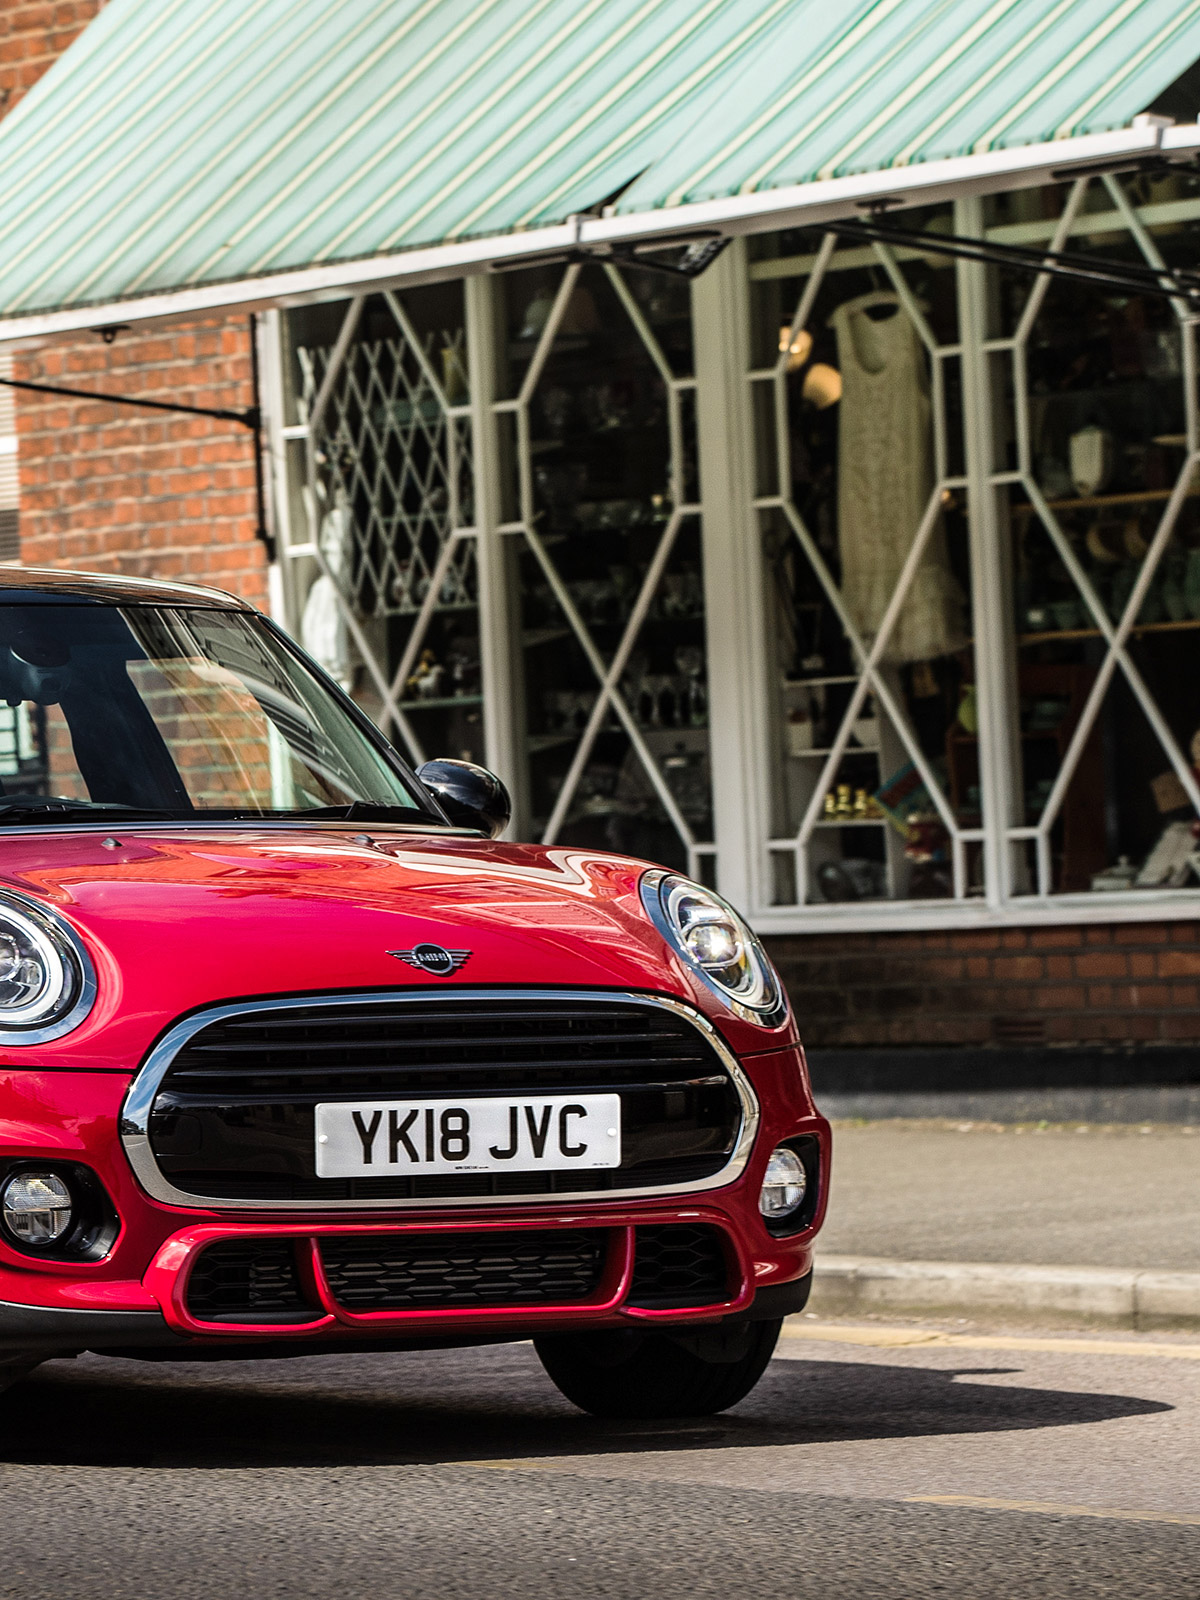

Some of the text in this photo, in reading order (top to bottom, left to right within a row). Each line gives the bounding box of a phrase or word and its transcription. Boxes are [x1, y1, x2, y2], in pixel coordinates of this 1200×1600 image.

[417, 952, 449, 962] MINI
[351, 1104, 588, 1164] YK18 JVC
